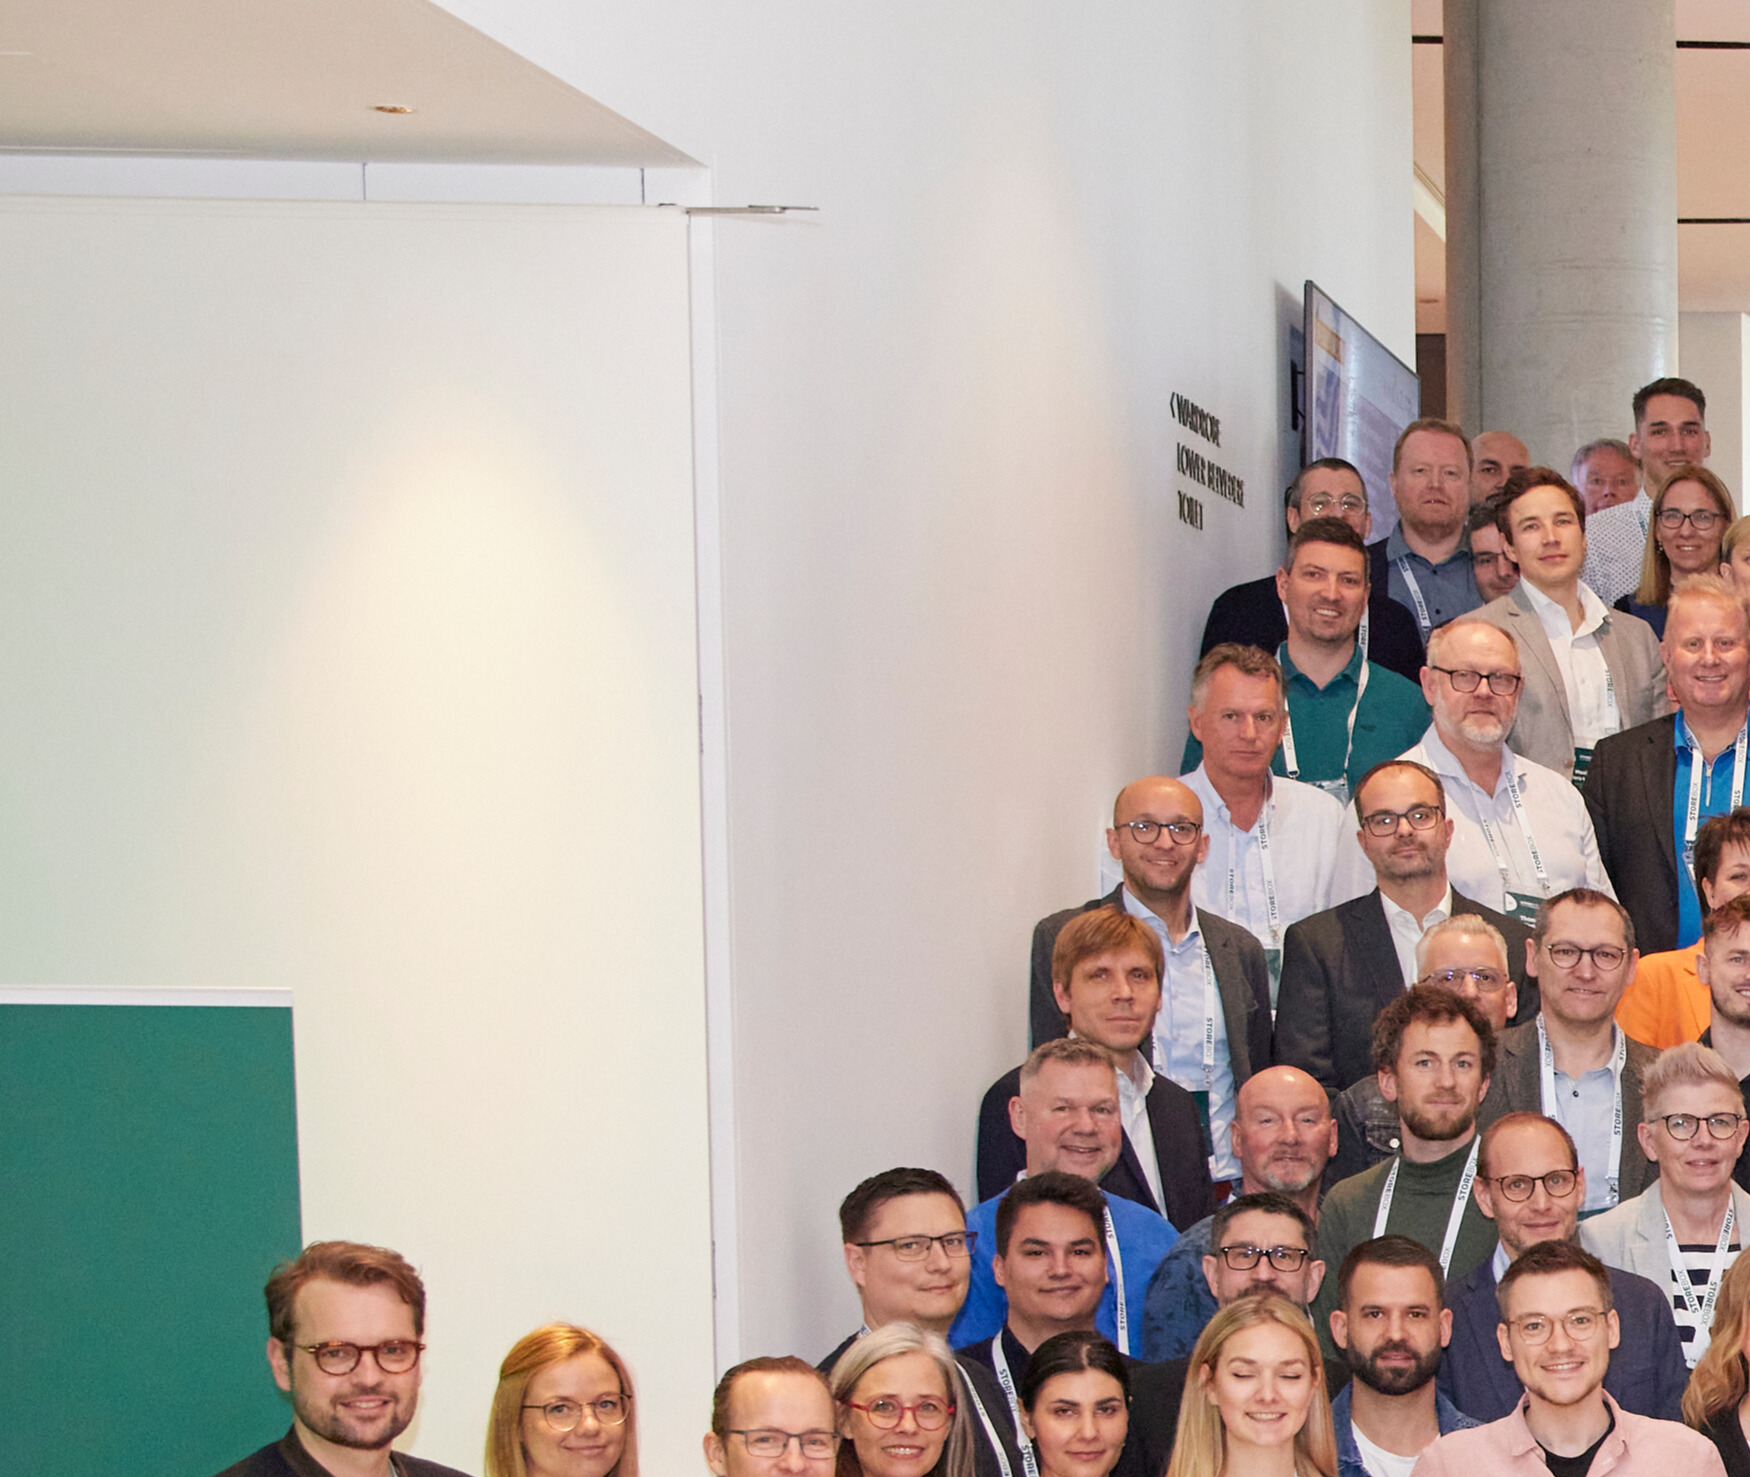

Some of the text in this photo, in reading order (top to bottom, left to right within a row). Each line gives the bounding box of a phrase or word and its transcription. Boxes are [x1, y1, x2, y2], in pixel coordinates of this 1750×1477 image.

[1689, 781, 1699, 822] STOREBOX
[1458, 1155, 1479, 1202] STOREBOX
[1676, 1267, 1699, 1314] STOREBOX
[1700, 1279, 1719, 1327] STOREBOX
